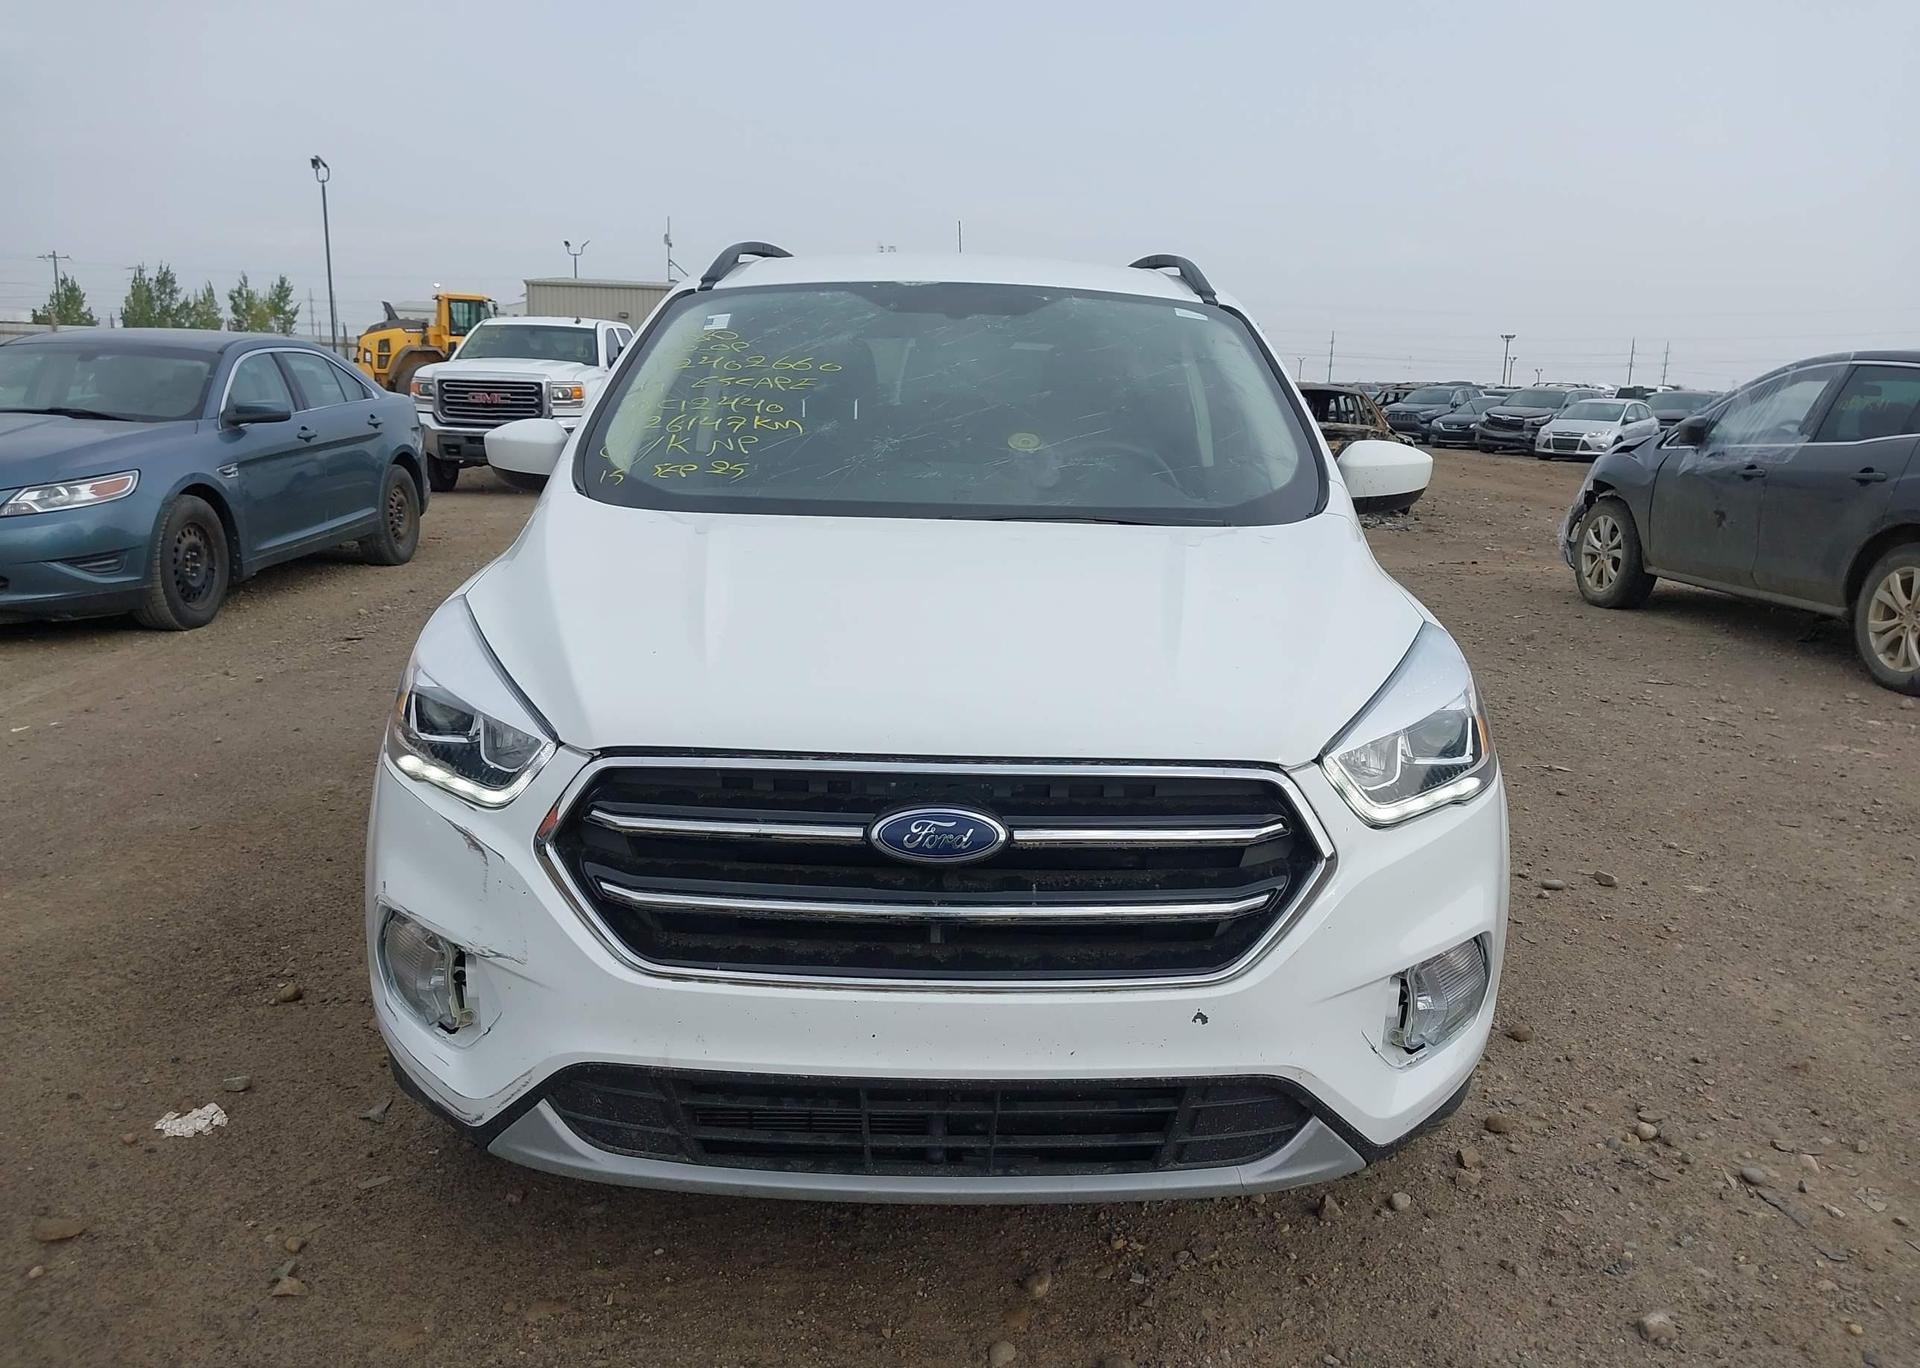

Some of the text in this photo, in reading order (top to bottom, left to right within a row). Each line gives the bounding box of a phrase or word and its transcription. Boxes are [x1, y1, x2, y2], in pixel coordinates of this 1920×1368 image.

[691, 376, 818, 391] ESCAPE
[468, 392, 511, 404] GMC
[903, 819, 976, 849] Ford
